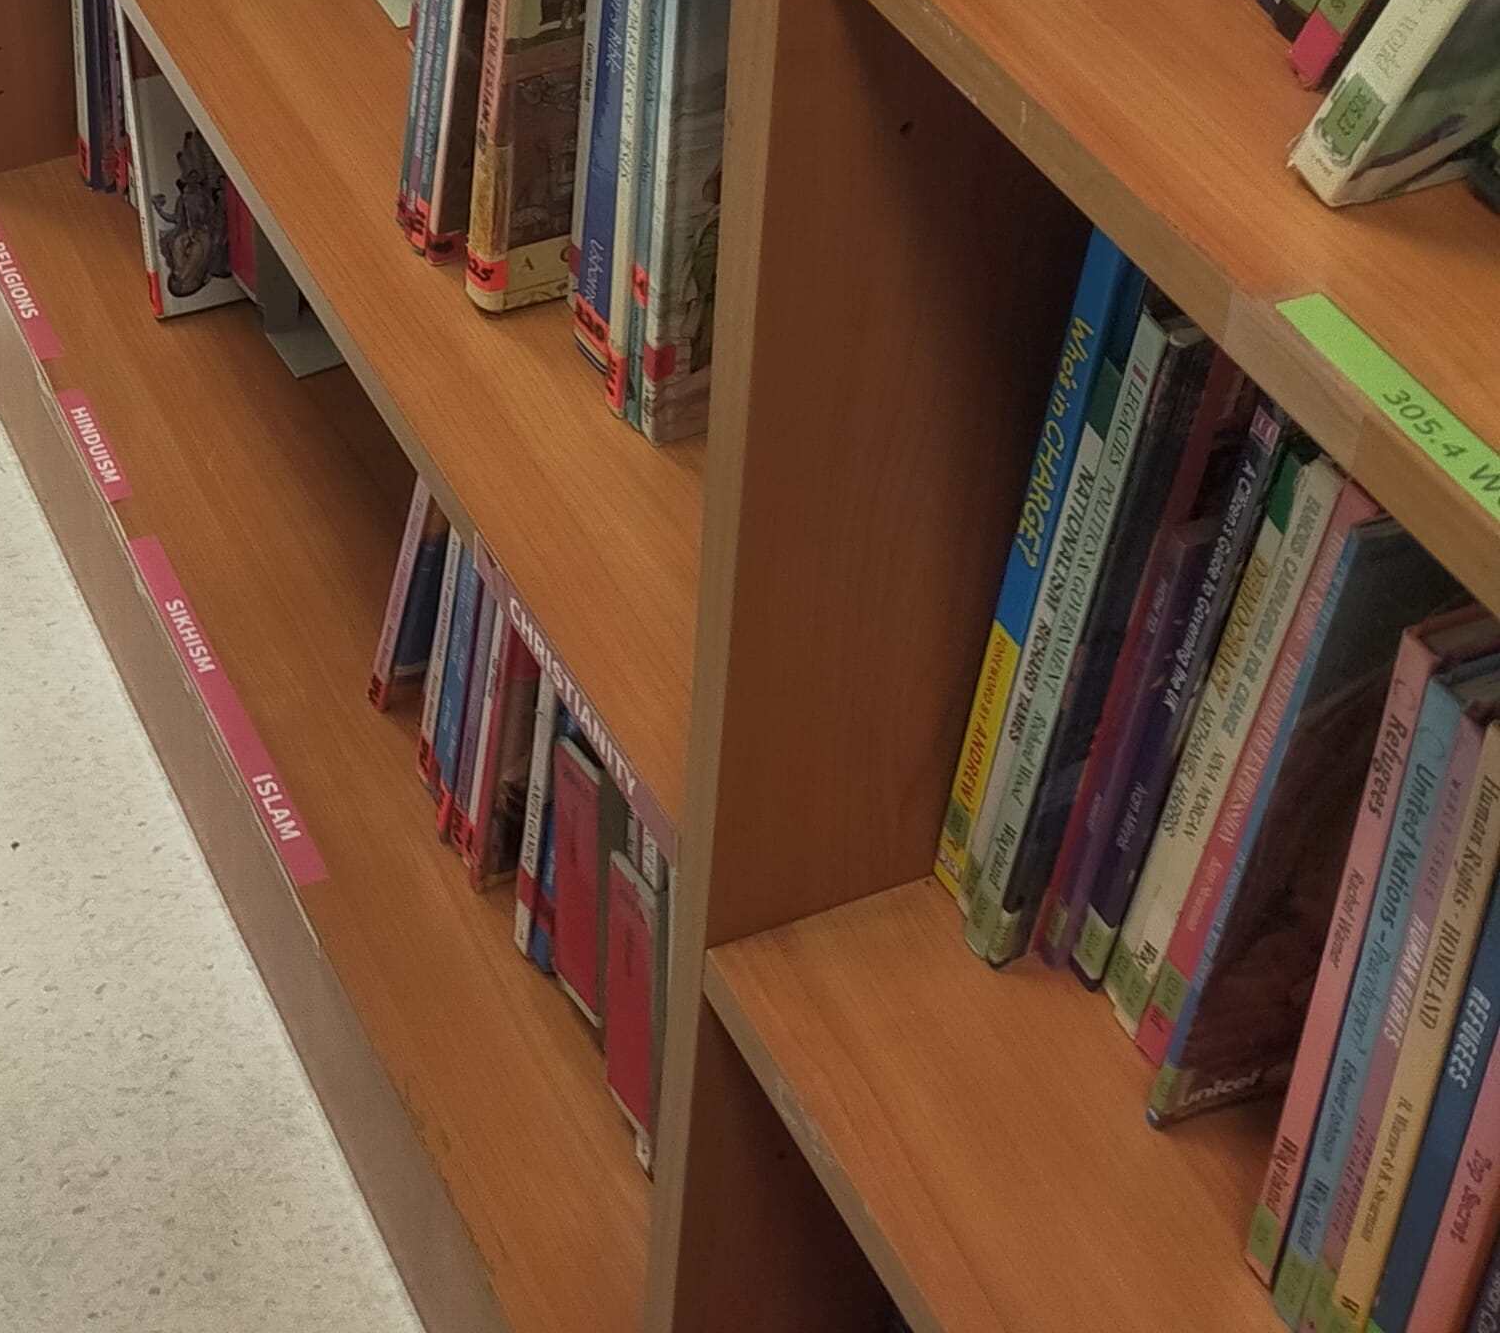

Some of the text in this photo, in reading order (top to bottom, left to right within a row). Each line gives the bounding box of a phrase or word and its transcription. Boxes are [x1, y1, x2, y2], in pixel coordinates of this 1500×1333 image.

[603, 25, 625, 81] Bible
[70, 404, 122, 486] HINDUISM
[1013, 315, 1096, 569] Who's in CHARGE?
[1109, 378, 1150, 470] LEGACIES
[1383, 389, 1466, 459] 305.4
[1241, 460, 1258, 478] A
[1050, 464, 1097, 614] NATIONALISM
[165, 596, 216, 676] SIKHISM
[1021, 617, 1051, 688] RICHARD
[1179, 594, 1211, 666] Governing
[1214, 555, 1270, 697] DEMOCRACY
[508, 595, 638, 799] CHRISTIANITY
[1008, 686, 1033, 743] TAMES
[1161, 690, 1179, 716] UK
[1171, 664, 1188, 692] the
[956, 721, 989, 815] ANDREW
[1368, 712, 1409, 820] Refugees
[1399, 761, 1439, 841] United
[251, 772, 302, 844] ISLAM
[987, 822, 1018, 890] Wayland
[1379, 836, 1420, 929] Nations
[1342, 867, 1366, 921] Rachel
[1418, 773, 1500, 1031] Human Rights HOMELAND
[1326, 917, 1353, 971] Warner
[1396, 911, 1431, 978] HUMAN
[1382, 973, 1414, 1051] RIGHTS
[1448, 987, 1491, 1090] REFUGEES
[1176, 1067, 1263, 1108] unicef
